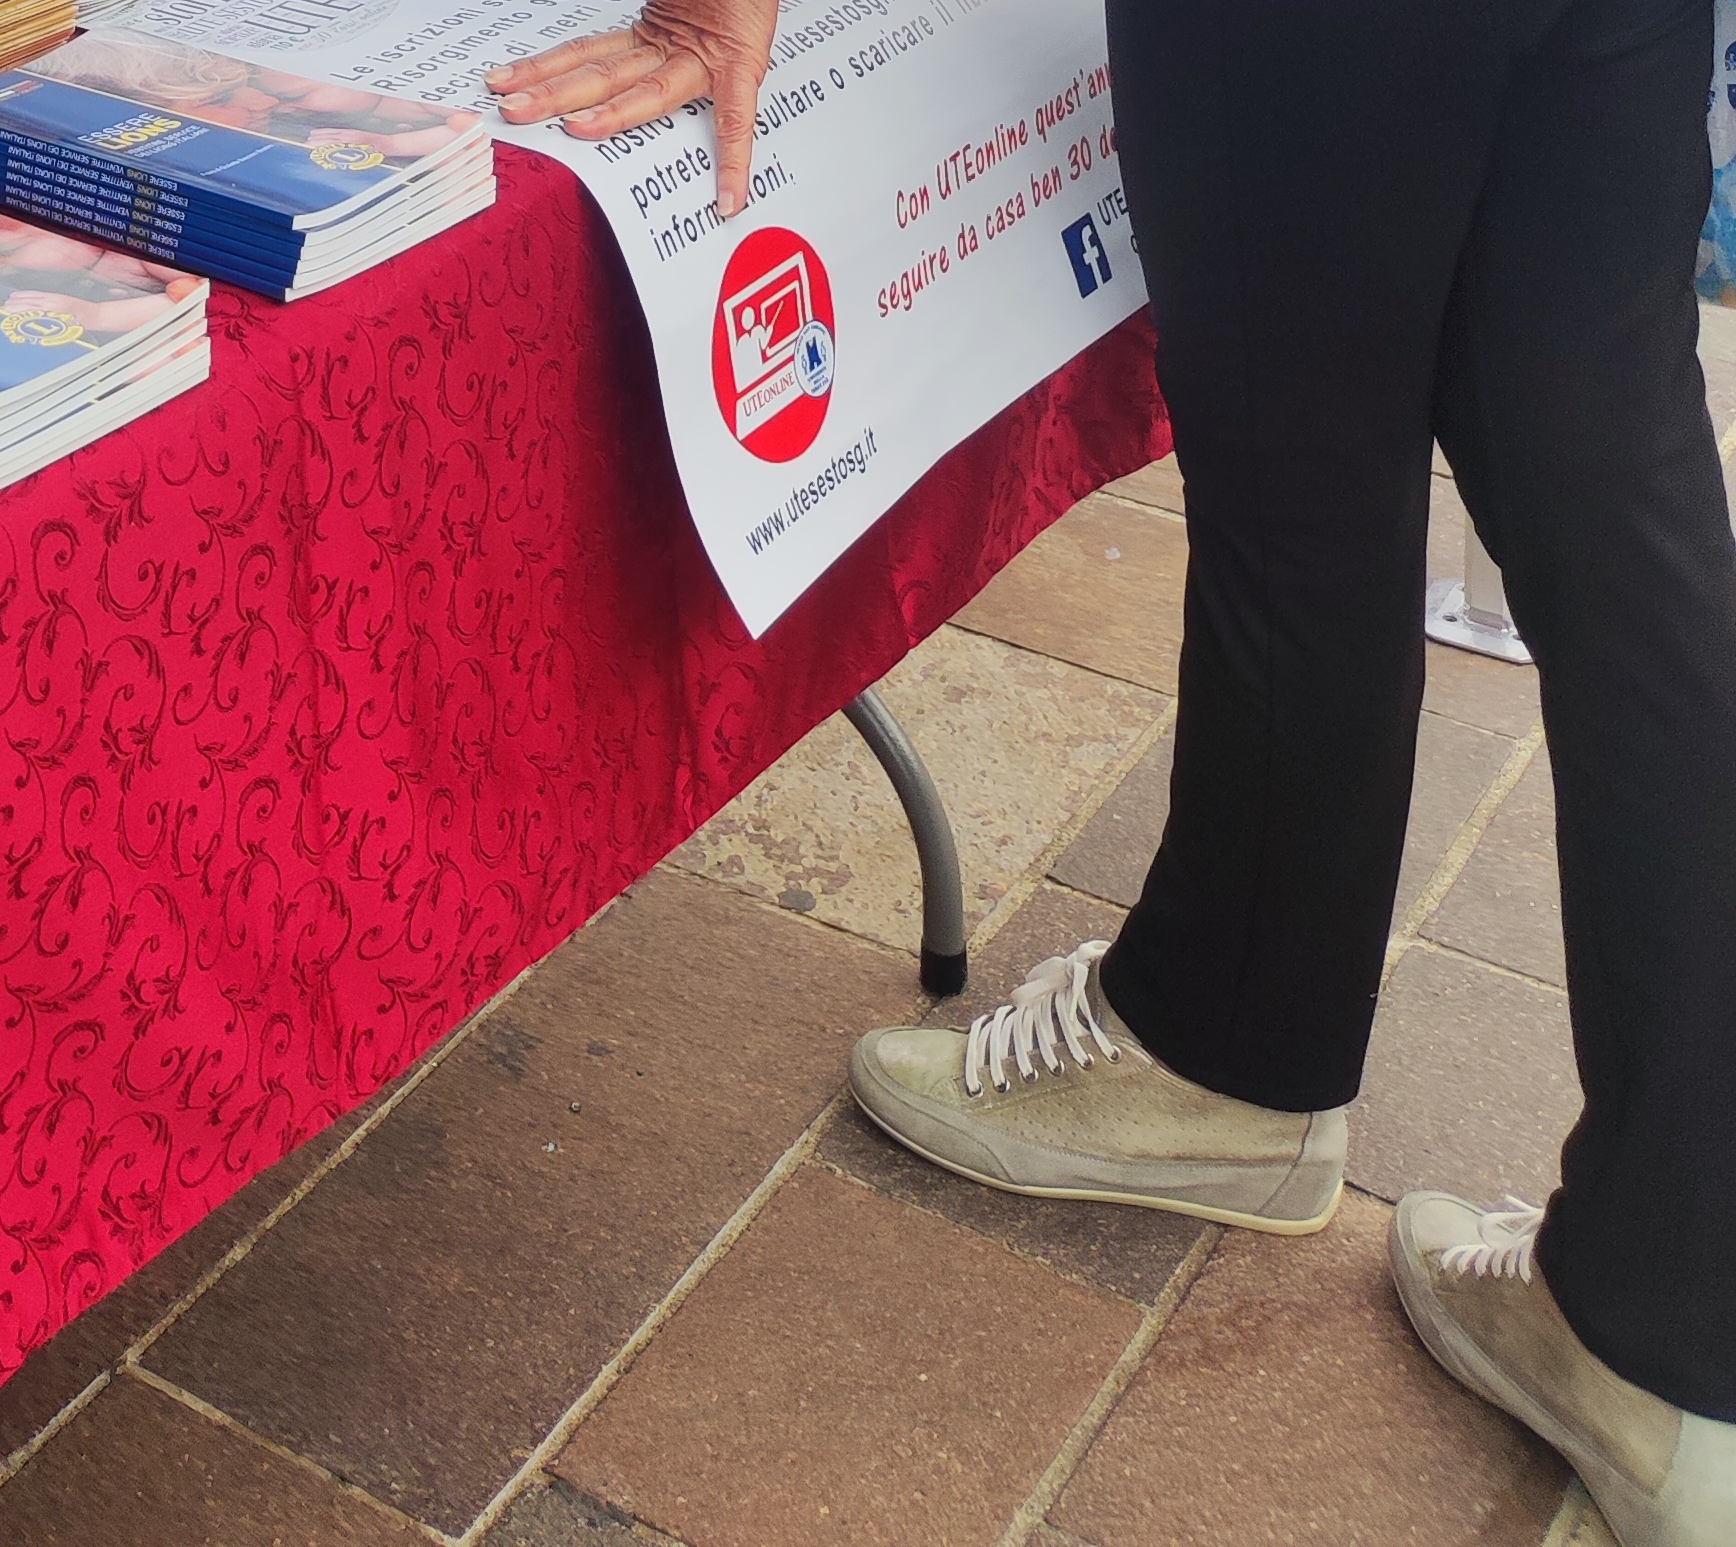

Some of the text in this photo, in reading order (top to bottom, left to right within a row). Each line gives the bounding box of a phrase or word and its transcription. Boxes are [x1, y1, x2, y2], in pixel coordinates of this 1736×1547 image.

[330, 64, 370, 82] Le
[368, 7, 486, 64] iscrizioni
[370, 10, 534, 93] Risorgimento
[419, 57, 504, 103] decina
[504, 39, 539, 58] di
[536, 5, 603, 40] metri
[96, 117, 184, 154] LIONS
[629, 150, 712, 212] potrete
[753, 79, 826, 140] sultare
[828, 67, 845, 90] o
[847, 14, 935, 78] scaricare
[894, 188, 931, 230] Con
[934, 124, 1030, 197] UTEonline
[1096, 186, 1128, 226] UTE
[876, 135, 1093, 319] seguire da casa ben 30
[745, 426, 878, 557] www.utesestosg.it
